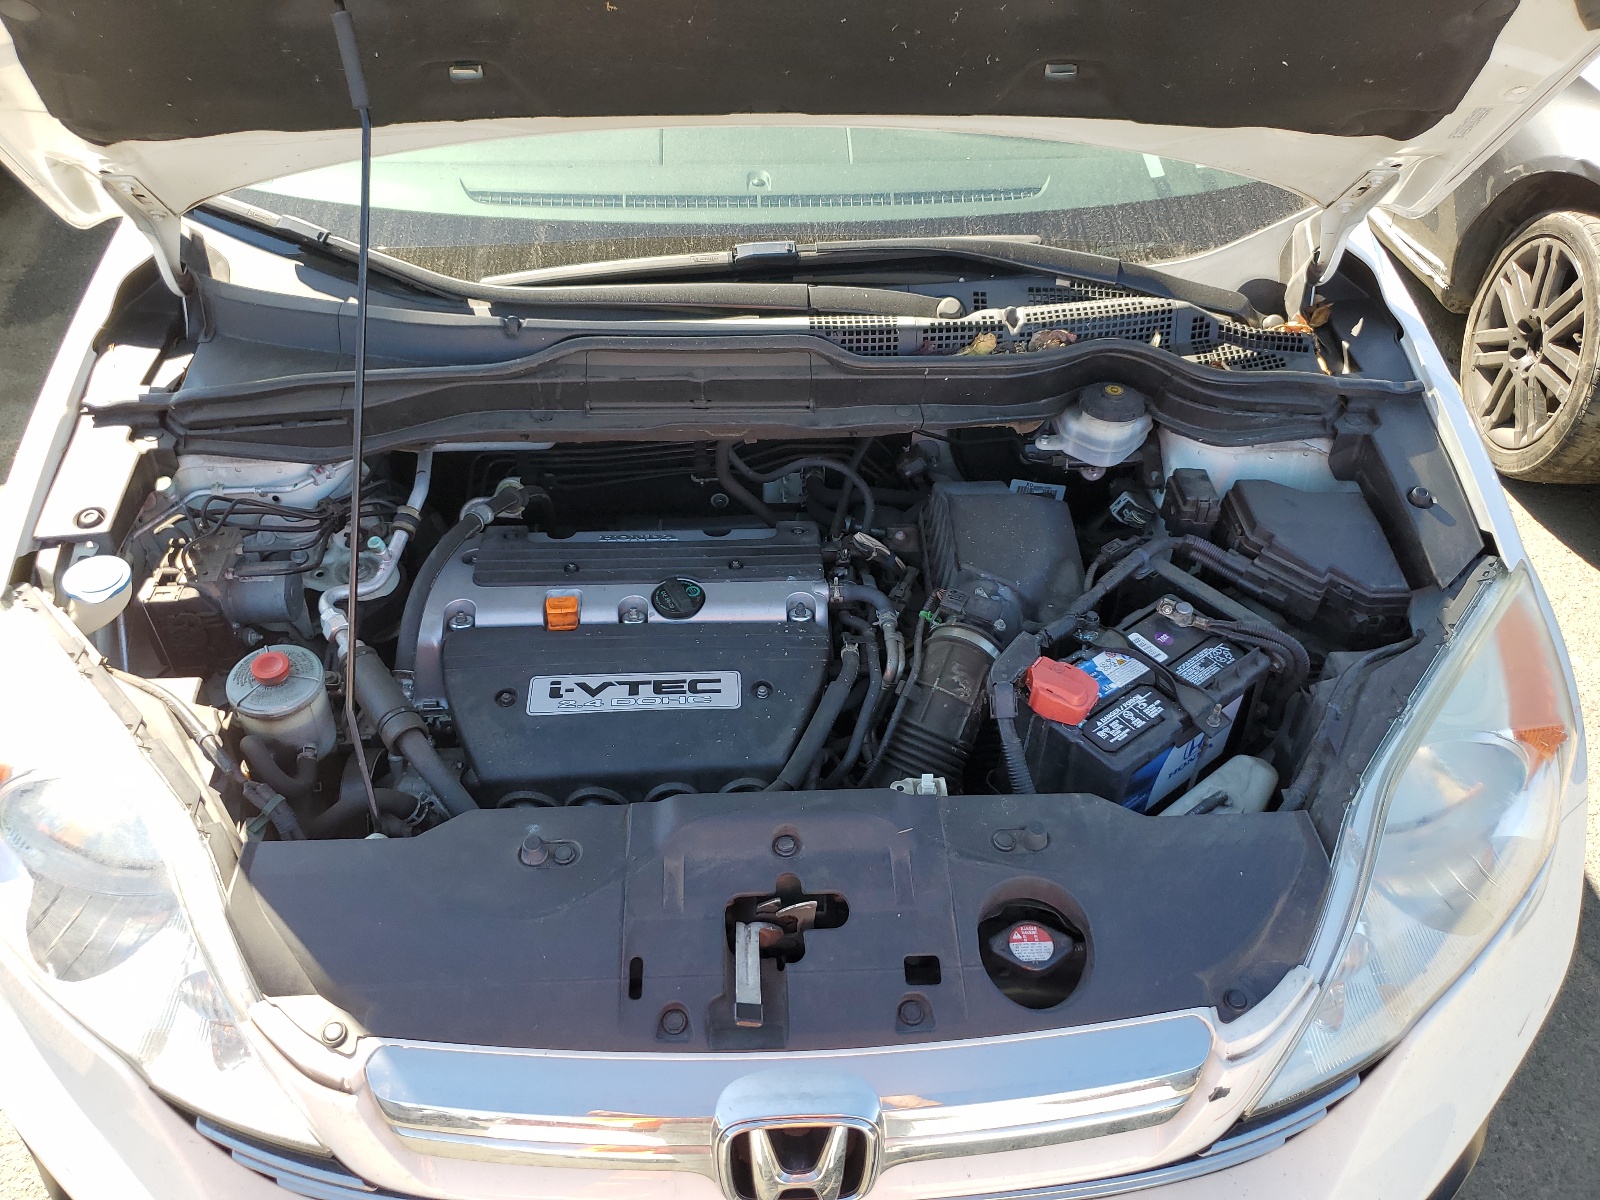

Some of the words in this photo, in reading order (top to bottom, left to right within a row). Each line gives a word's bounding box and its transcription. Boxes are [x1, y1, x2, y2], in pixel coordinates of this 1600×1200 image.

[598, 534, 679, 542] HONDA
[548, 678, 721, 699] i-VTEC
[557, 698, 605, 709] 2.4
[610, 695, 712, 707] DOHC
[1100, 707, 1121, 722] DANGER
